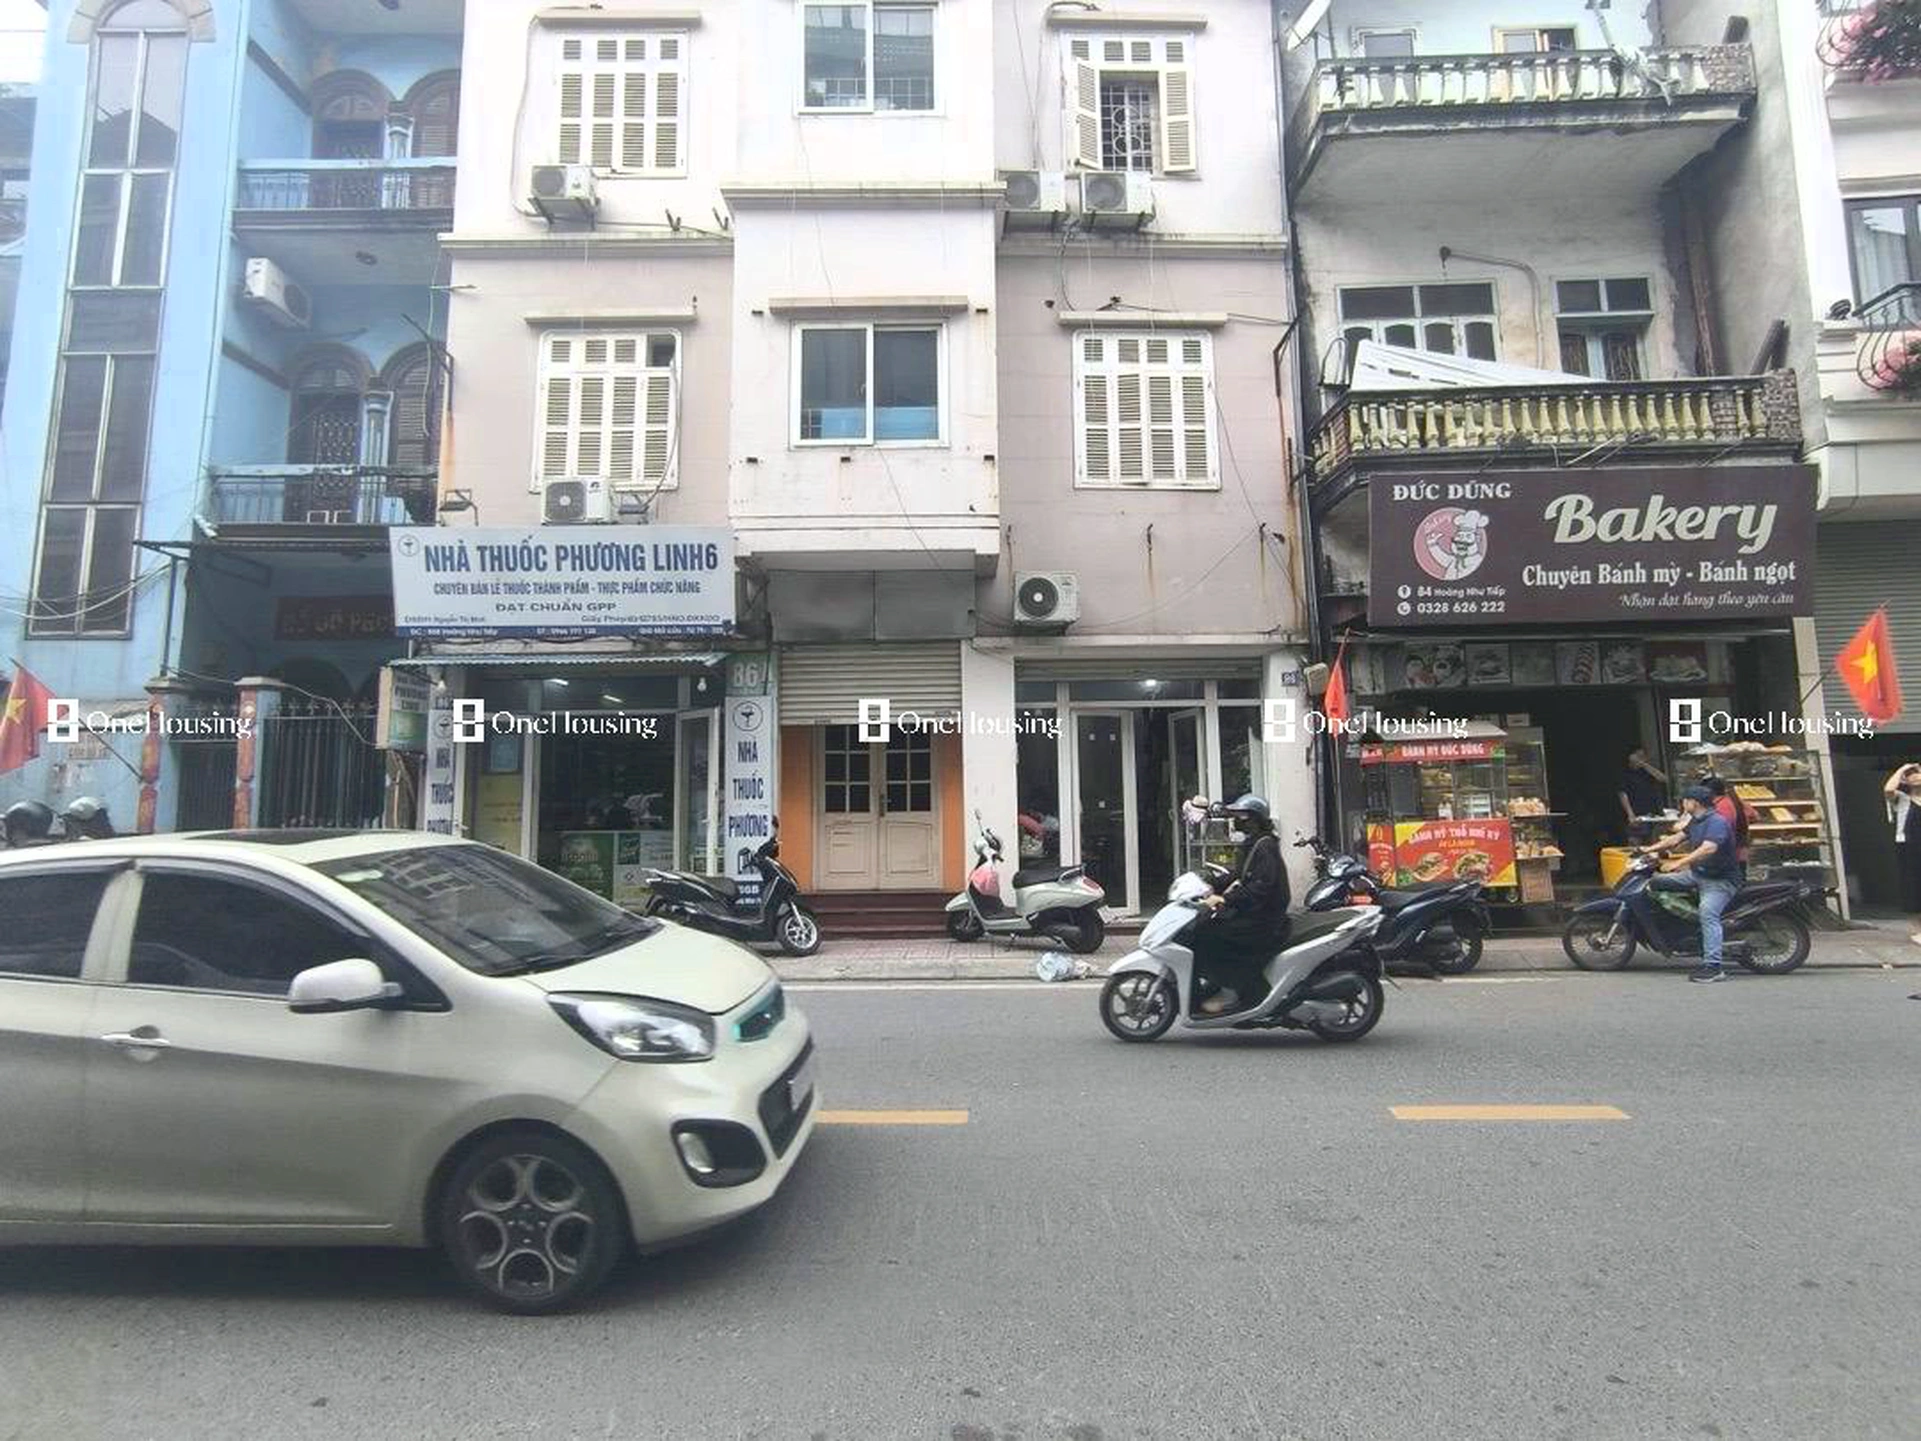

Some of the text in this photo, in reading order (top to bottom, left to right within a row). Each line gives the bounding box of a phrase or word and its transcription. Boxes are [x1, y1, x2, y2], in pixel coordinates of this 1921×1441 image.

[1393, 479, 1512, 501] ĐỨC DŨNG
[1544, 494, 1778, 554] Bakery
[424, 539, 471, 573] NHÀ
[476, 534, 548, 572] THUỐC
[555, 541, 646, 572] PHƯƠNG
[1522, 563, 1592, 590] Chuyên
[1598, 560, 1647, 585] Bánh
[1699, 559, 1748, 583] Bánh
[1754, 561, 1797, 584] ngọt
[586, 602, 617, 612] GPP
[1417, 600, 1506, 614] 0328 626 222
[733, 769, 765, 800] THUỐC
